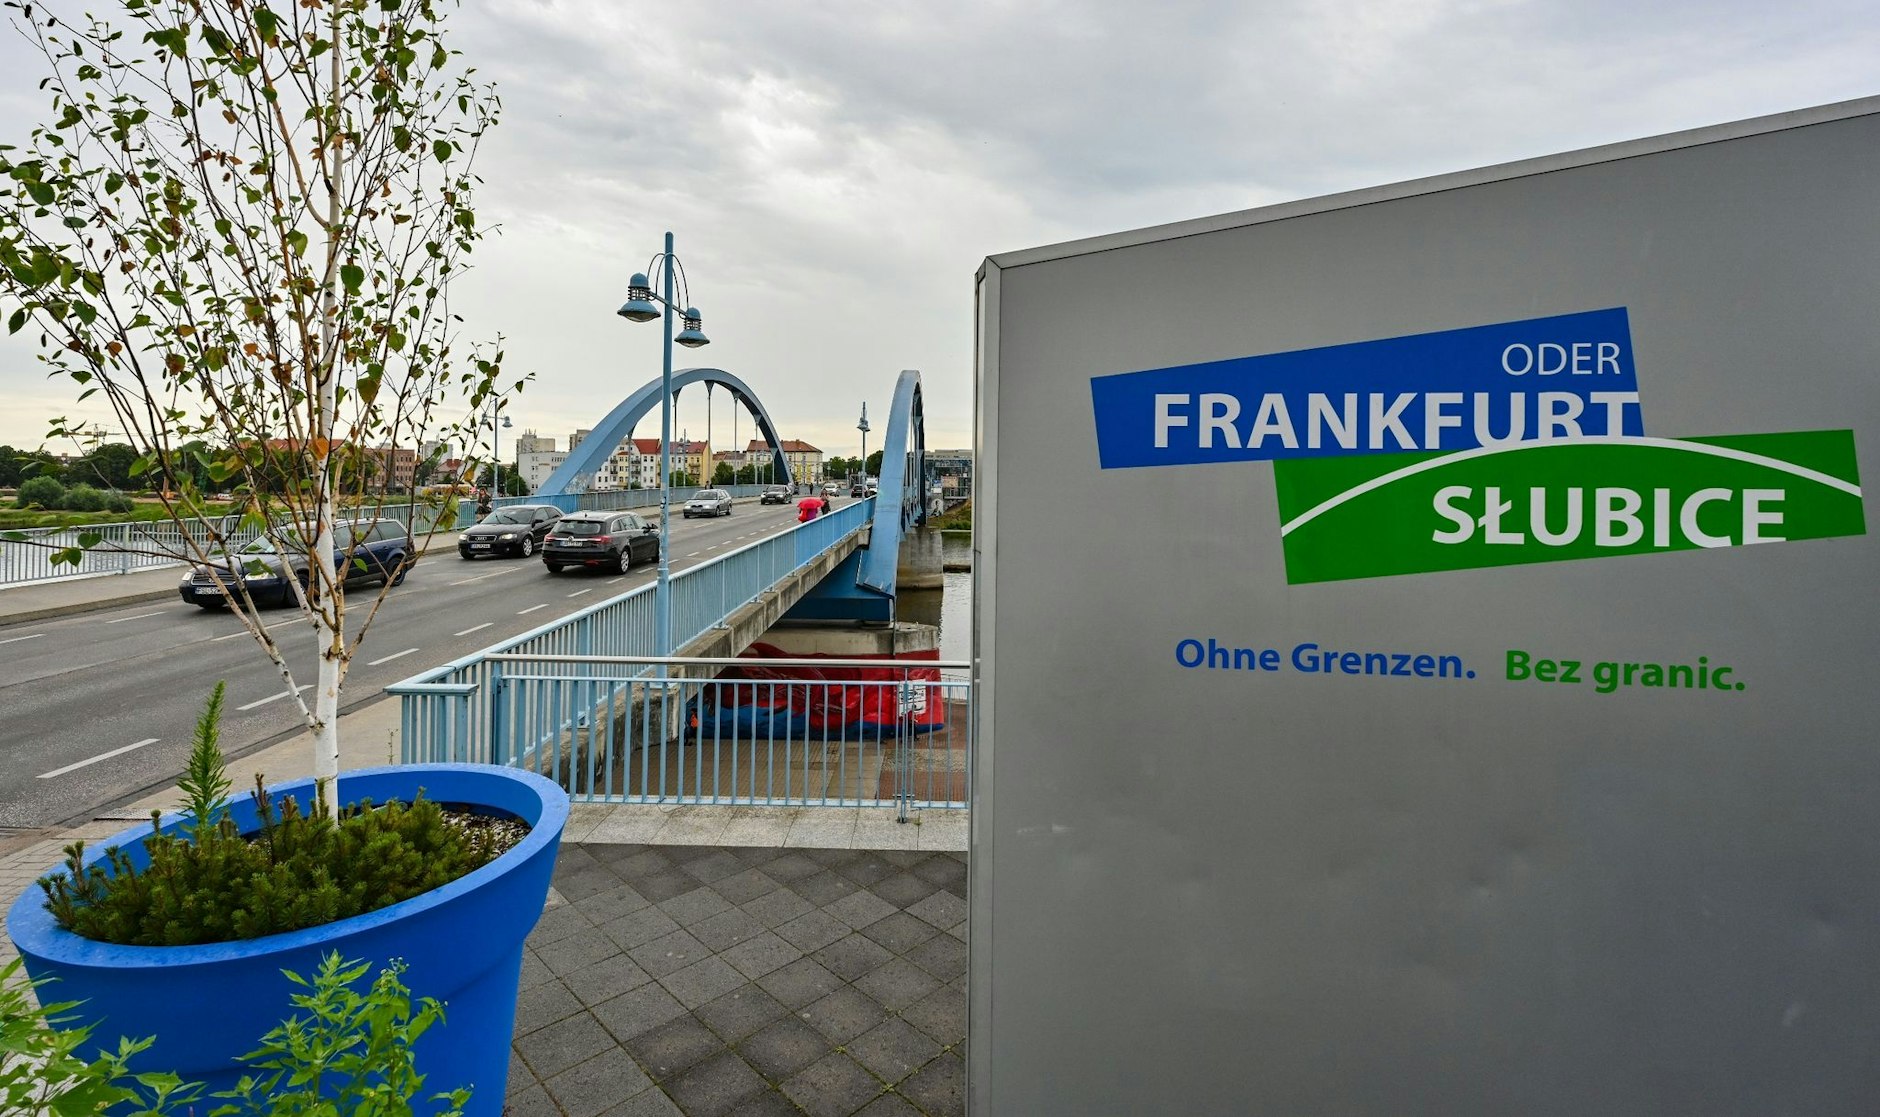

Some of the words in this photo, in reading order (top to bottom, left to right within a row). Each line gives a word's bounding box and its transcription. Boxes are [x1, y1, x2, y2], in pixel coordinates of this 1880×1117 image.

[1502, 343, 1621, 375] ODER
[1154, 392, 1640, 450] FRANKFURT
[1432, 486, 1787, 548] SŁUBICE
[1175, 638, 1281, 672] Ohne
[1291, 643, 1477, 680] Grenzen.
[1506, 649, 1583, 684] Bez
[1593, 656, 1746, 694] granic.
